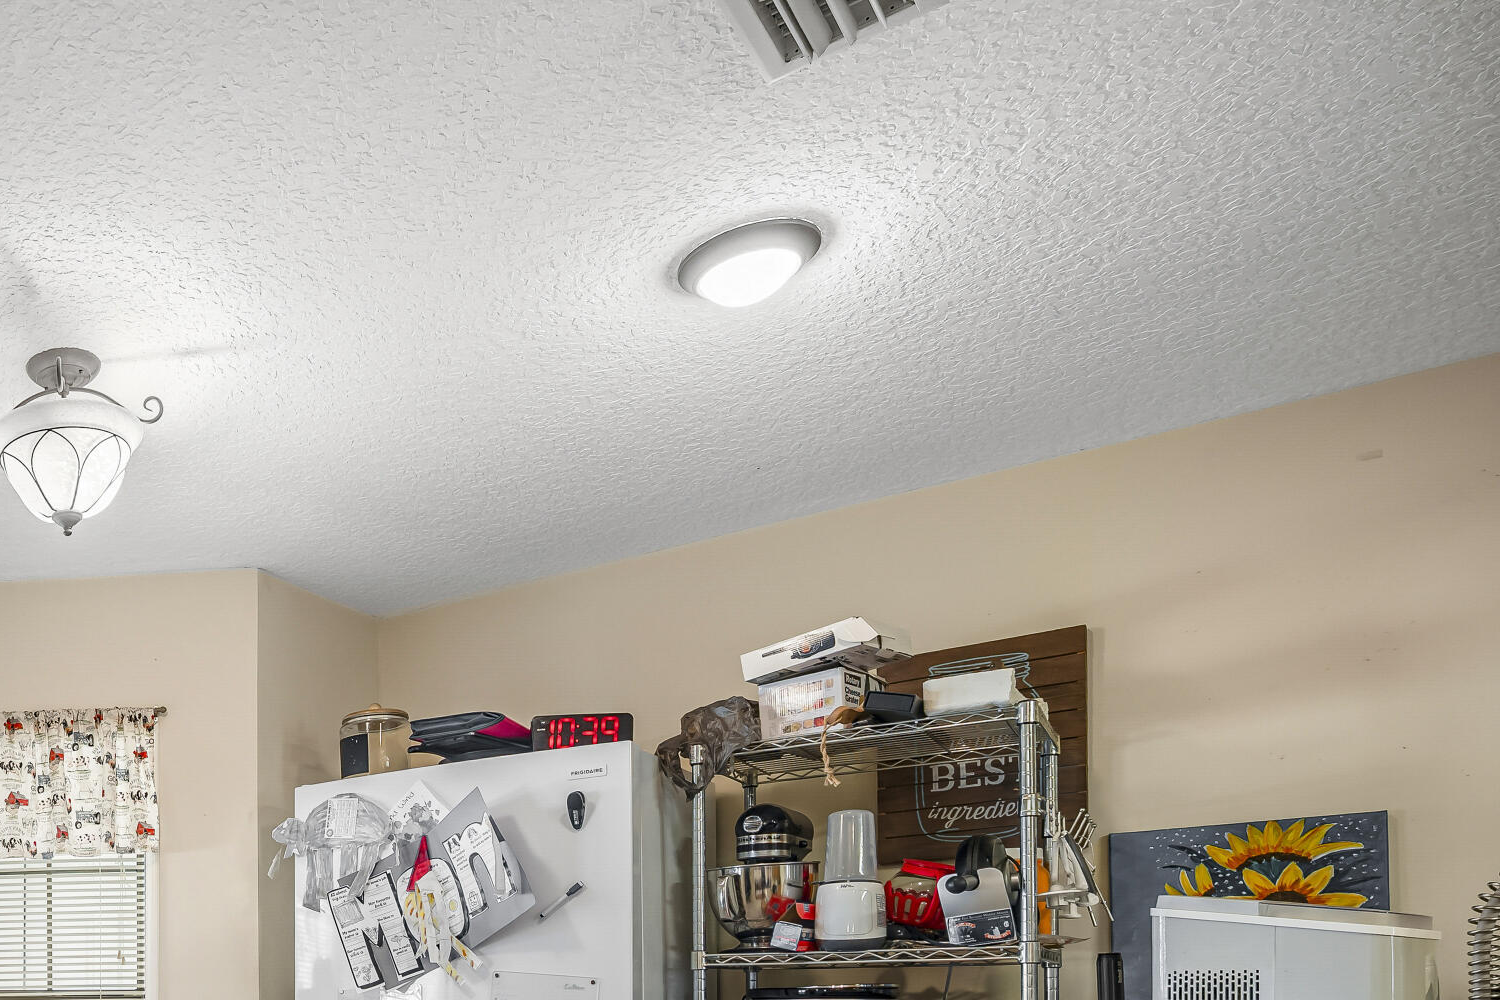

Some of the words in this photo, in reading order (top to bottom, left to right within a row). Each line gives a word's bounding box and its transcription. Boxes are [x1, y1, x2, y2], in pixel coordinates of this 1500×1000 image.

[845, 675, 861, 688] Rotary
[844, 686, 861, 698] Cheese
[548, 716, 620, 749] 10:39
[570, 767, 604, 776] FRIGIDAIRE
